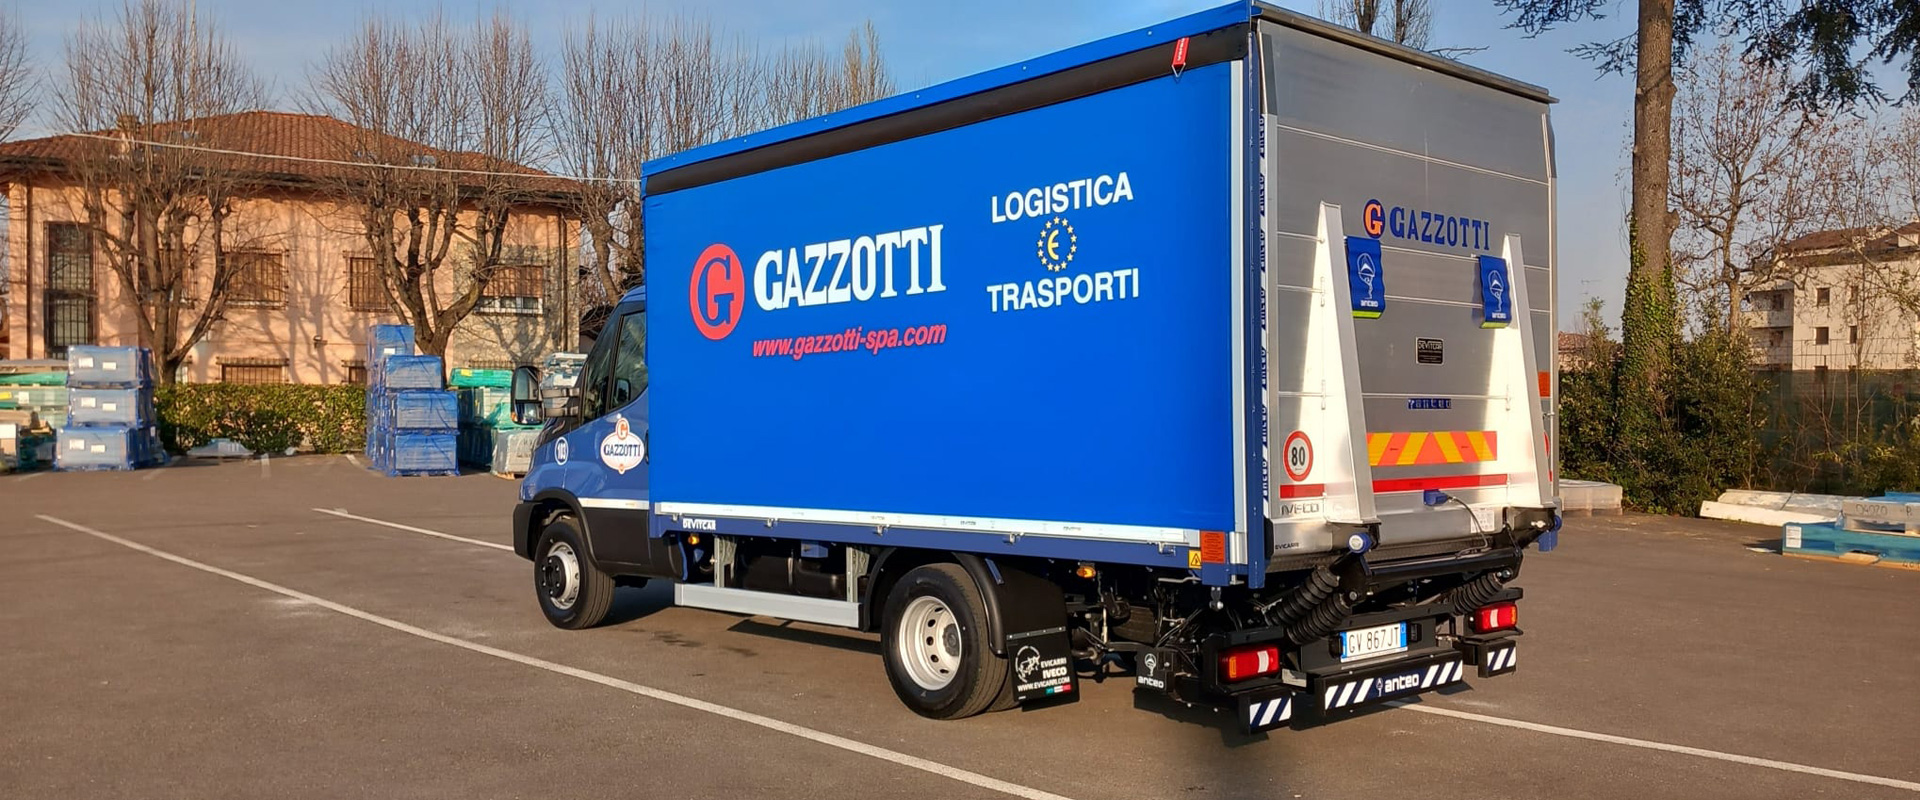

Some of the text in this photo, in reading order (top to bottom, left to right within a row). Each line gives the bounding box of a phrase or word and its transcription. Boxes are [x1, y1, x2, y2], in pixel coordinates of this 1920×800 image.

[991, 171, 1134, 224] LOGISTICA
[1364, 203, 1490, 251] G GAZZOTTI
[694, 224, 947, 332] G GAZZOTTI
[987, 268, 1140, 313] TRASPORTI
[752, 322, 947, 361] www.gazzotti-spa.com
[617, 421, 628, 438] G
[603, 444, 641, 457] GAZZOTTI
[1291, 446, 1306, 467] 80
[1281, 503, 1320, 516] IVECO
[1348, 627, 1399, 654] GV 867JT
[1040, 657, 1067, 669] EVICARRI
[1042, 666, 1067, 679] IVECO
[1017, 676, 1071, 692] WWW.EVICARRI.COM
[1137, 675, 1164, 689] anteo
[1385, 673, 1419, 693] anteo
